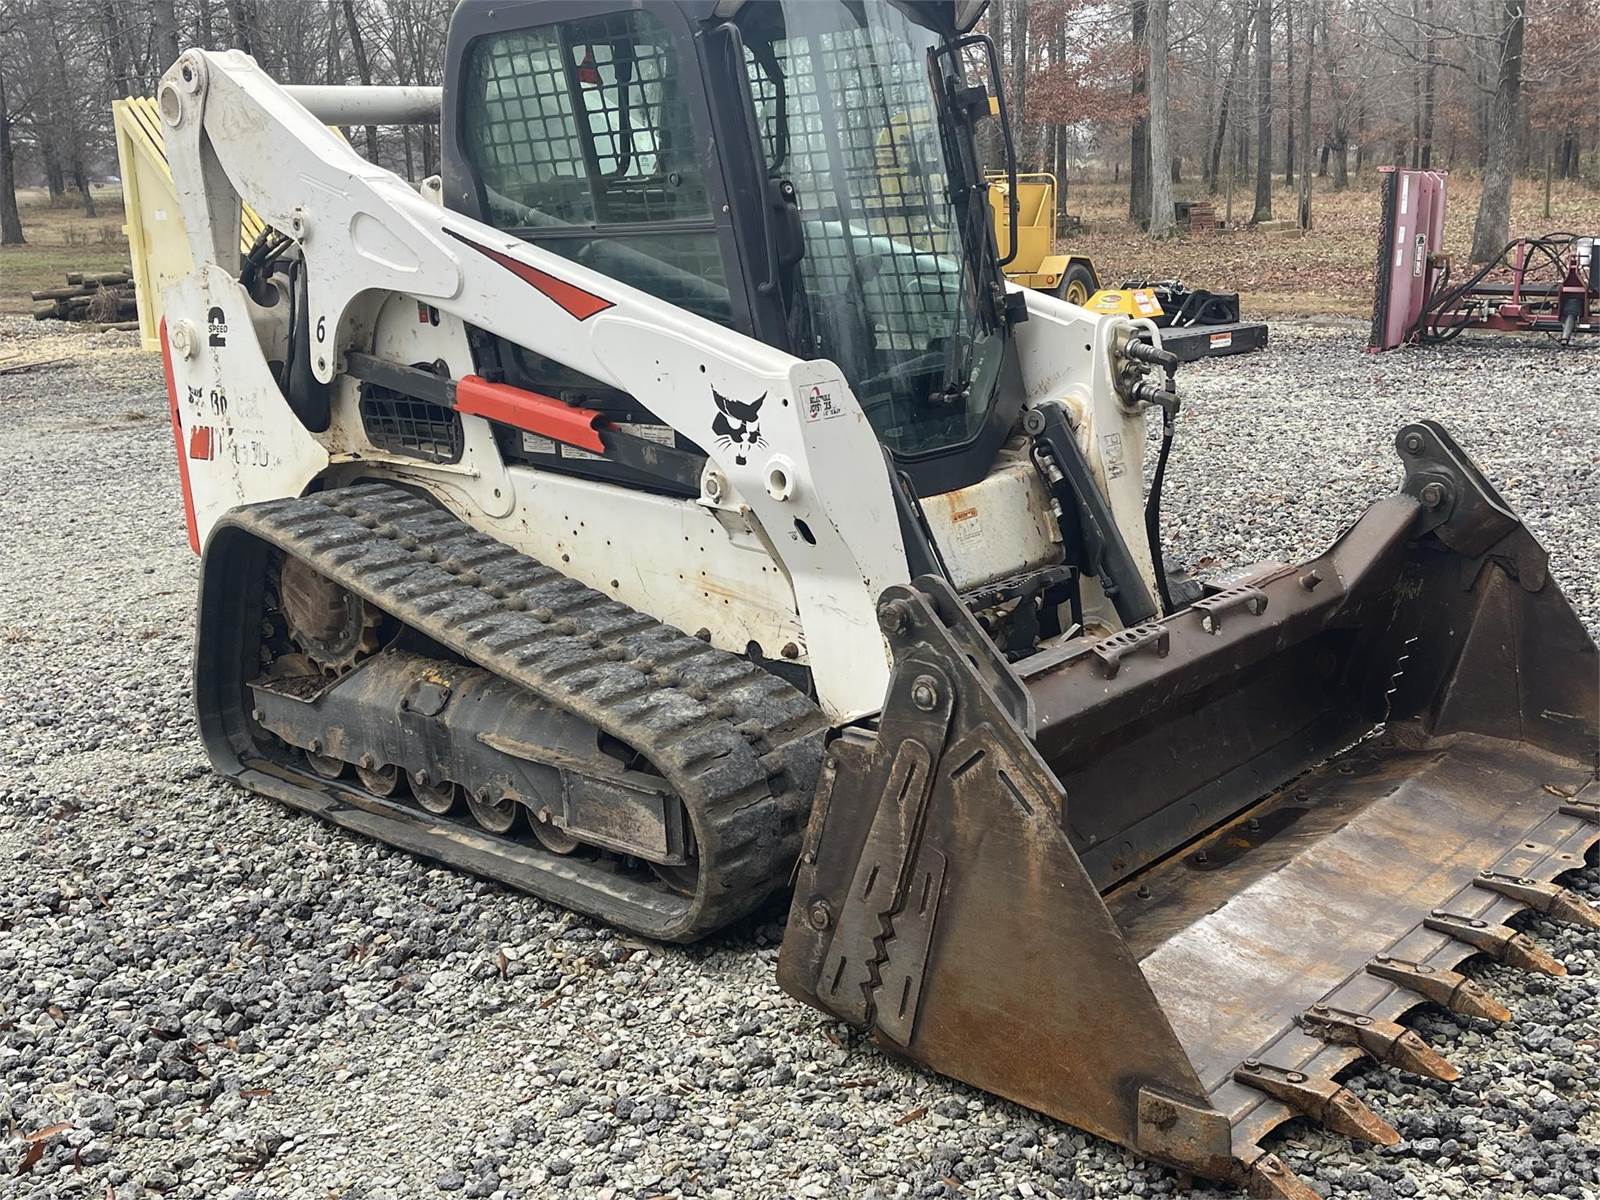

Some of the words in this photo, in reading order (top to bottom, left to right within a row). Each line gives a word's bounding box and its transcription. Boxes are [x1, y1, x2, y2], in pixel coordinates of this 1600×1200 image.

[208, 306, 226, 347] 2
[208, 324, 228, 333] SPEED
[316, 316, 326, 343] 6
